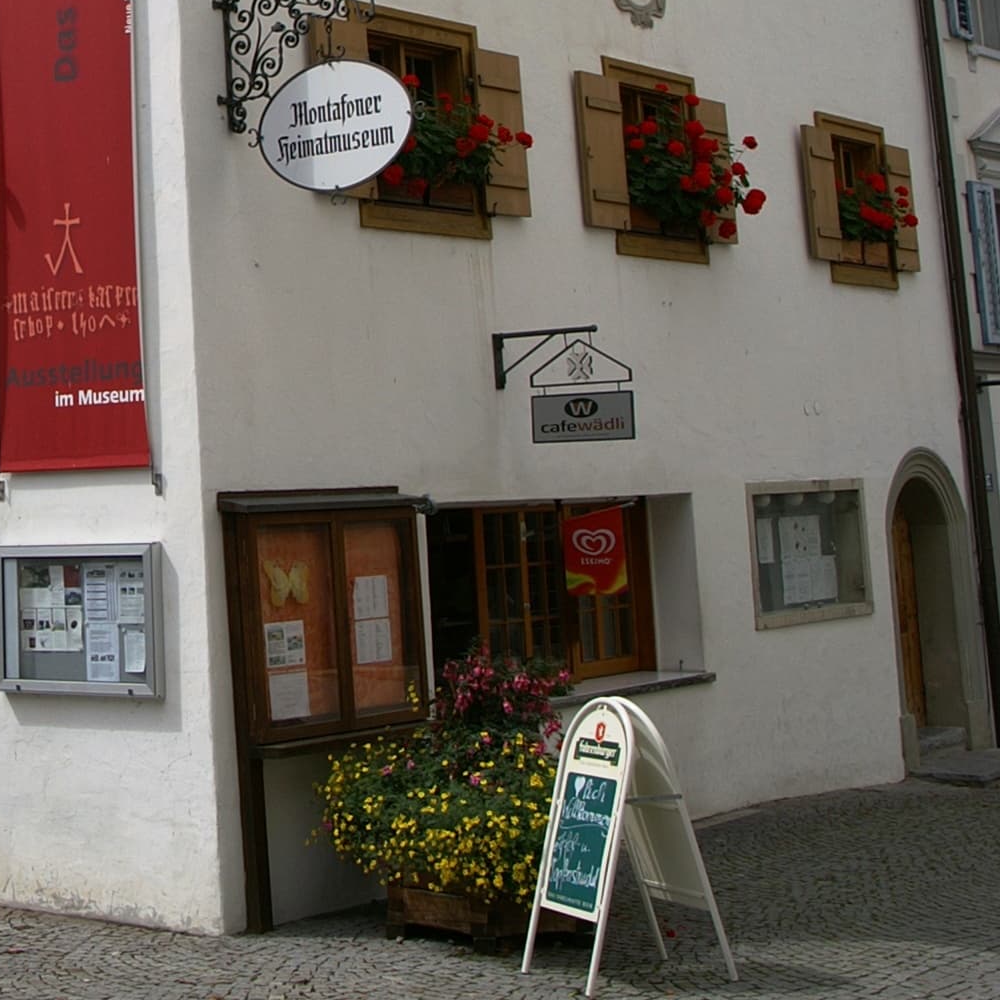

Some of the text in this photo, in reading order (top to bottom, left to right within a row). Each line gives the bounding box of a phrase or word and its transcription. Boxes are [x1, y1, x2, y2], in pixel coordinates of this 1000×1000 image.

[53, 7, 78, 82] Das
[289, 93, 382, 129] Montafoner
[277, 126, 395, 166] Heimatmuseum
[6, 358, 144, 389] Ausstellung
[55, 387, 145, 408] im Museum
